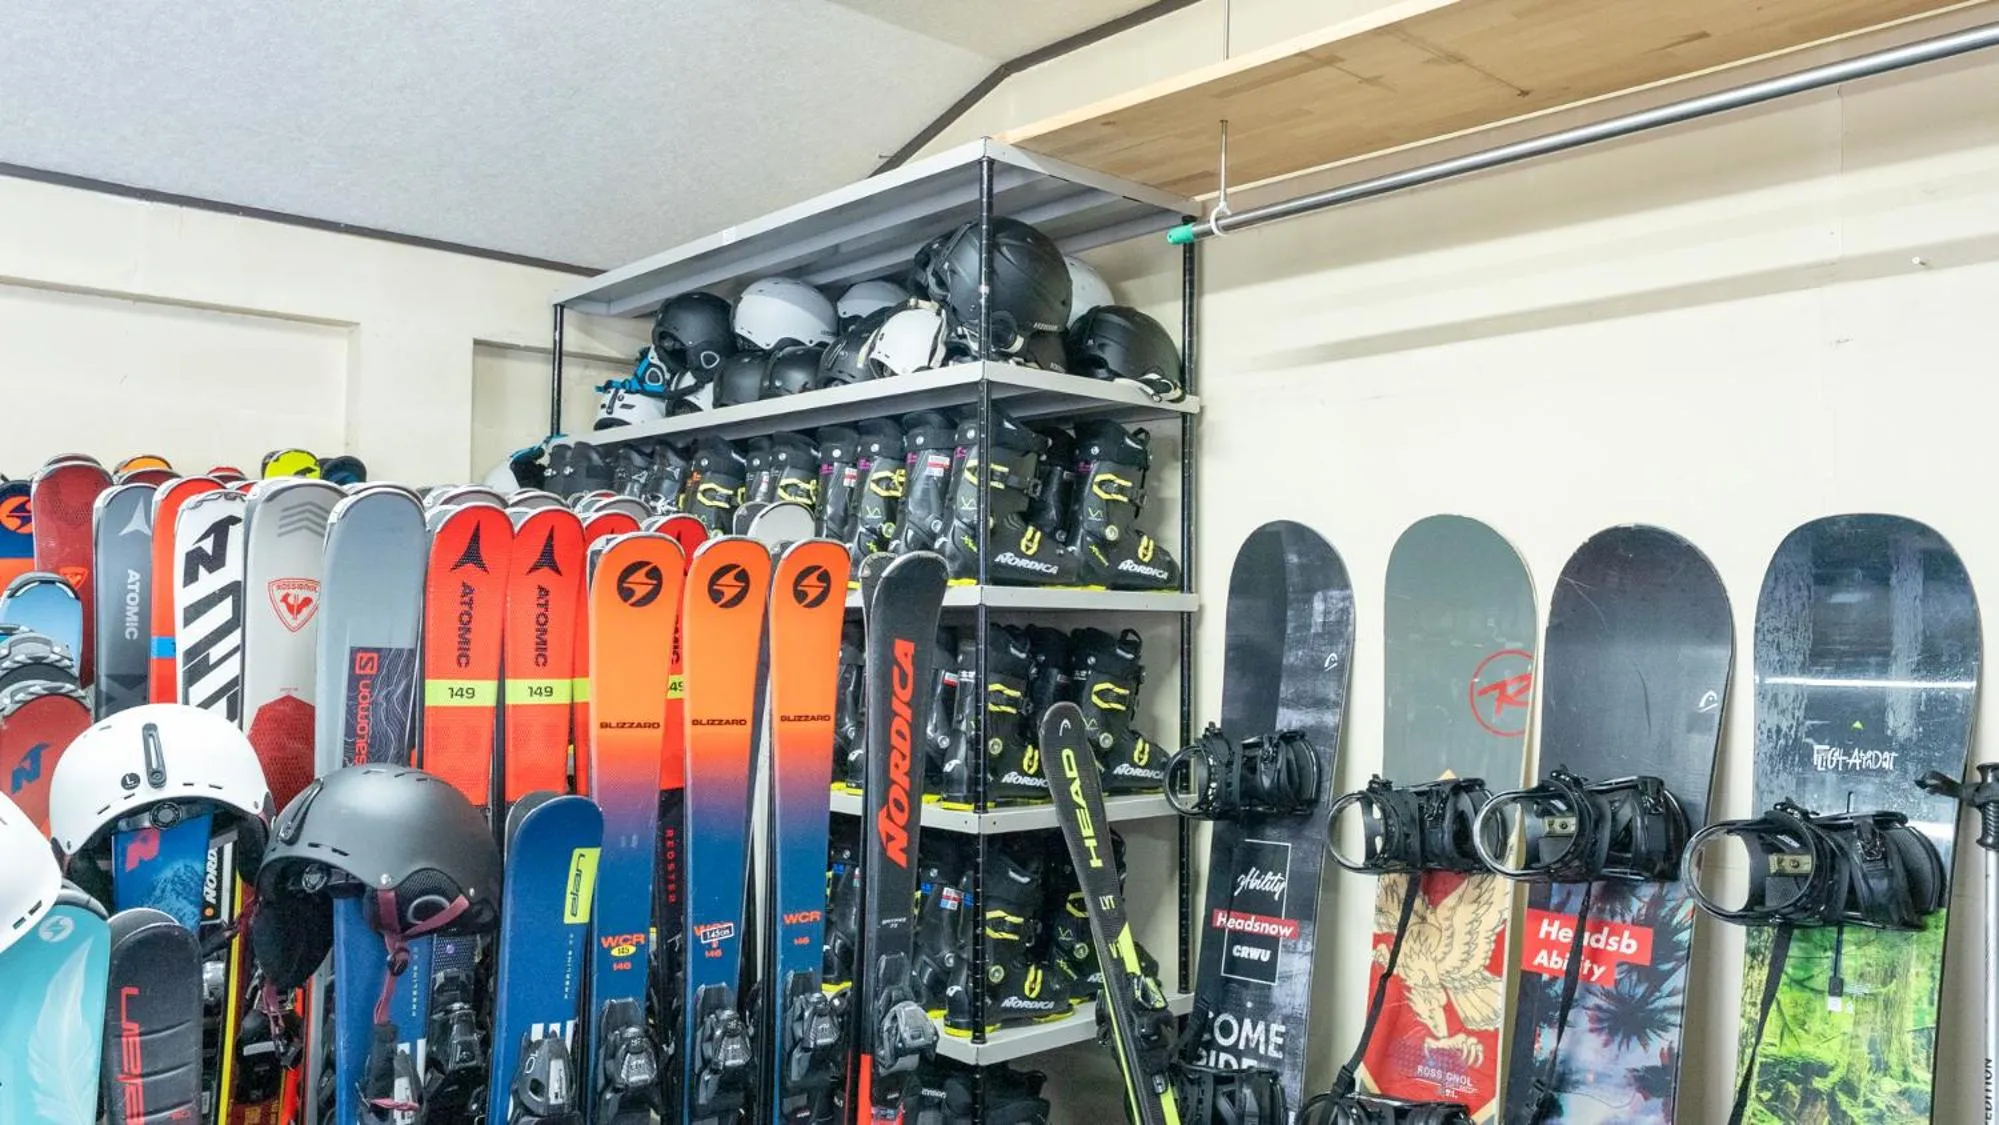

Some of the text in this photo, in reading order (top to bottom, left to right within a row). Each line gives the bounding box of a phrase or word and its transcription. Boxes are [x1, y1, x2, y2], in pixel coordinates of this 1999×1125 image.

[994, 552, 1059, 574] NORDICA
[1118, 559, 1168, 580] NORDICA
[124, 568, 141, 641] ATOMIC
[456, 581, 477, 668] ATOMIC
[534, 584, 550, 667] ATOMIC
[448, 686, 476, 700] 149
[527, 685, 554, 699] 149
[600, 722, 661, 730] BLIZZARD
[692, 718, 747, 726] BLIZZARD
[780, 714, 831, 722] BLIZZARD
[878, 637, 915, 869] NORDICA
[1002, 771, 1049, 788] NORDIC
[1061, 748, 1103, 868] HEAD
[783, 911, 821, 925] WCR
[1216, 912, 1294, 937] Headsnow
[600, 933, 646, 948] WCR
[1001, 996, 1054, 1010] NORDICA
[1202, 1011, 1286, 1059] OME
